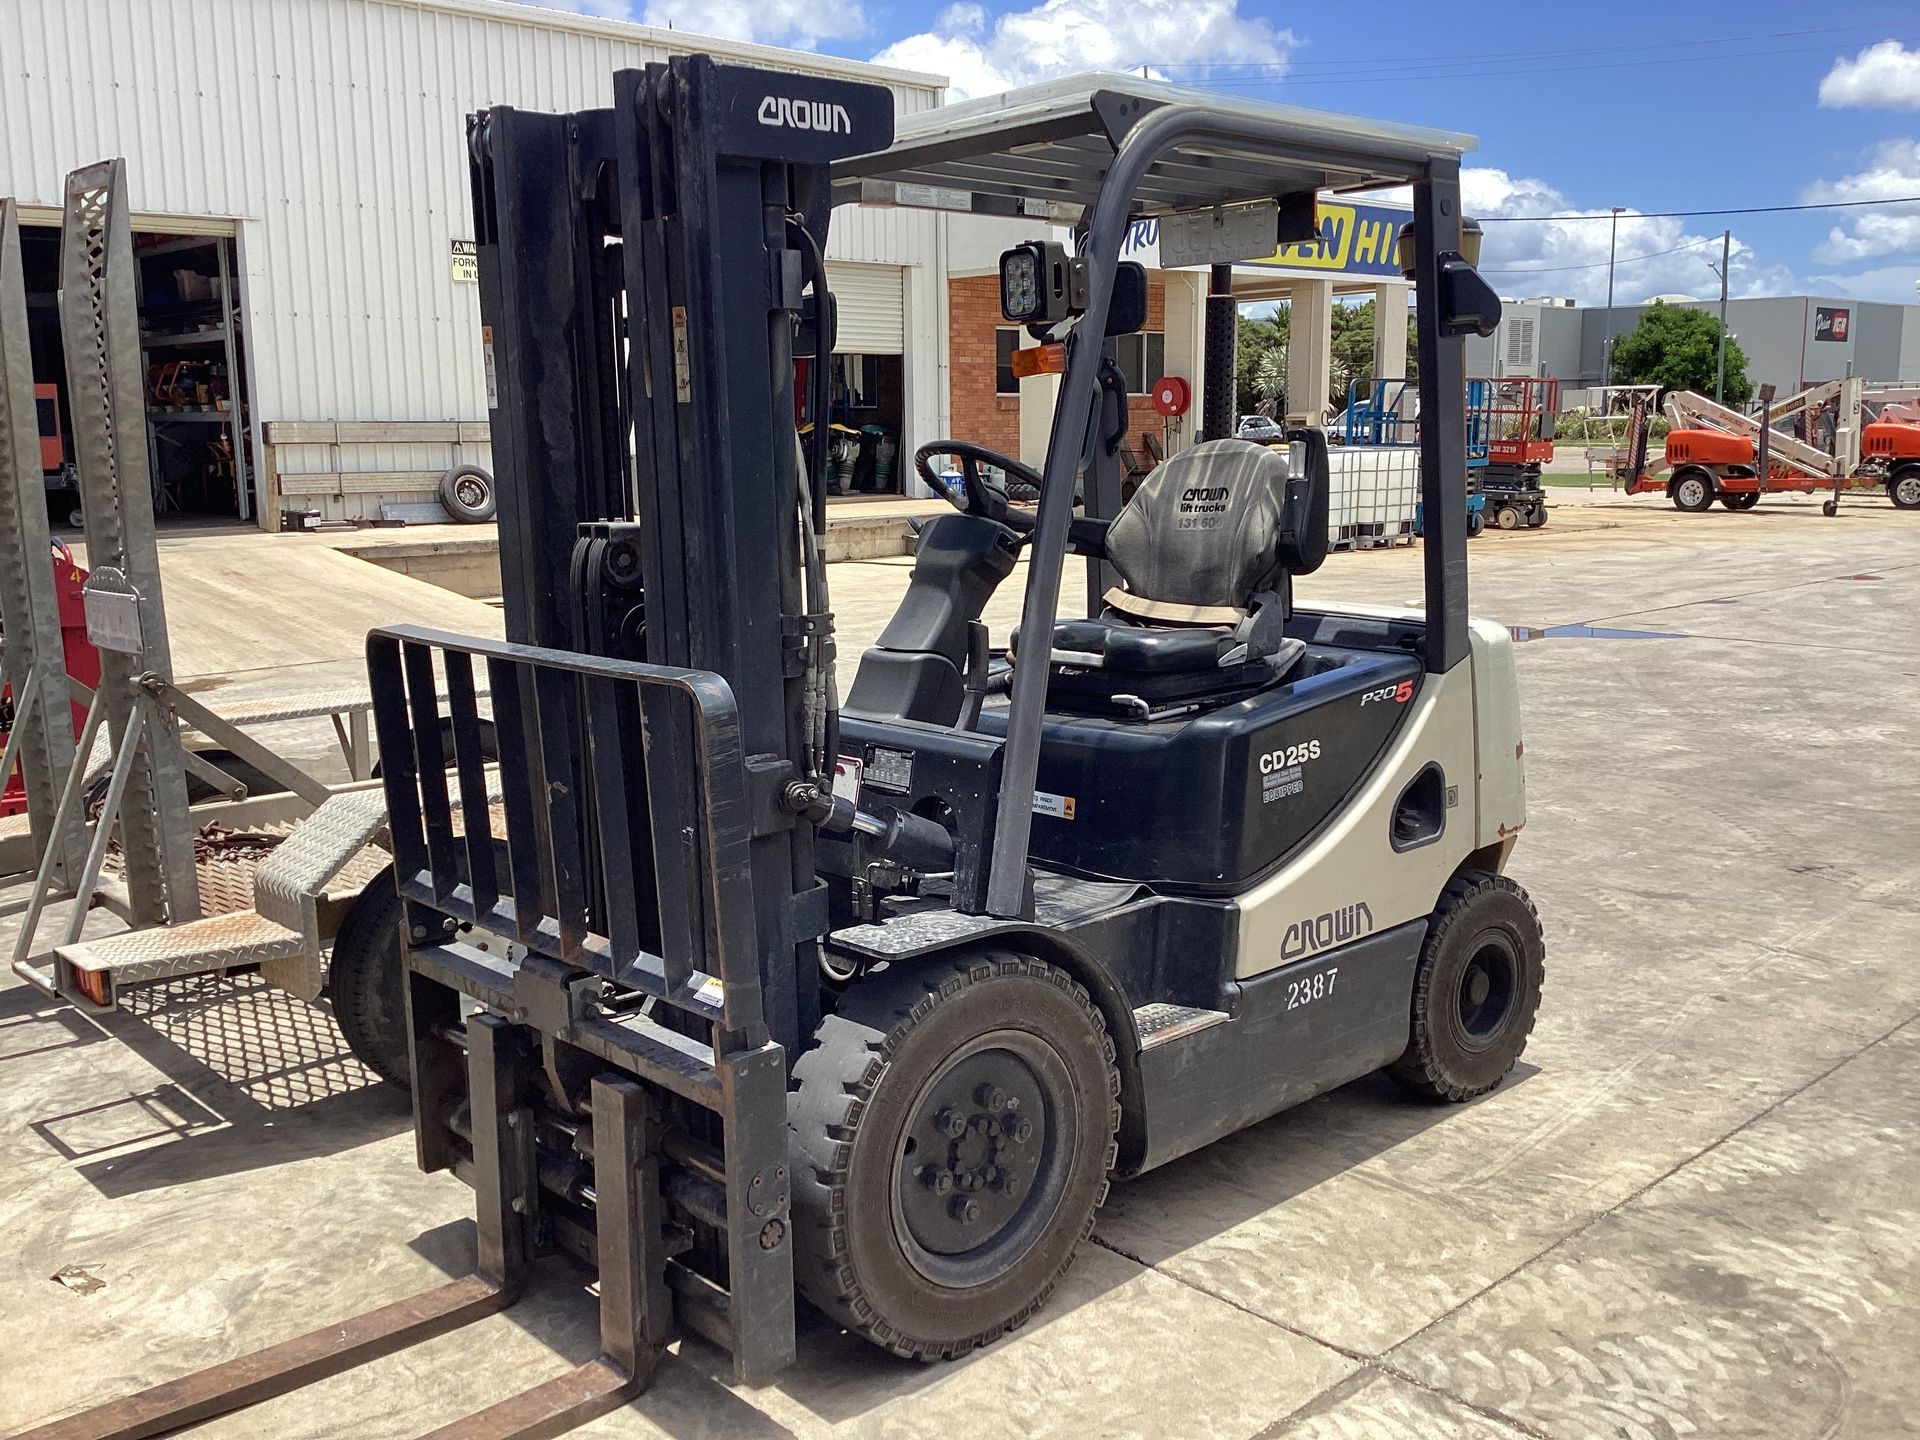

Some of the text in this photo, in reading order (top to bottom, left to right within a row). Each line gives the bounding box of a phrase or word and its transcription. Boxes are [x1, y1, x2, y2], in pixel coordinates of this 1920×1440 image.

[758, 96, 851, 134] CROWN
[462, 242, 476, 254] WA
[1355, 219, 1400, 266] HI
[463, 269, 472, 279] IN
[1502, 446, 1517, 454] 3219
[1182, 487, 1229, 501] CROWN
[1180, 502, 1226, 513] lift trucks
[1178, 518, 1198, 529] 131
[1360, 680, 1413, 707] PRO5
[1260, 739, 1321, 774] CD25S
[1263, 780, 1304, 804] EQUIPPED
[1281, 901, 1373, 961] CROWN
[1287, 967, 1338, 1011] 2387
